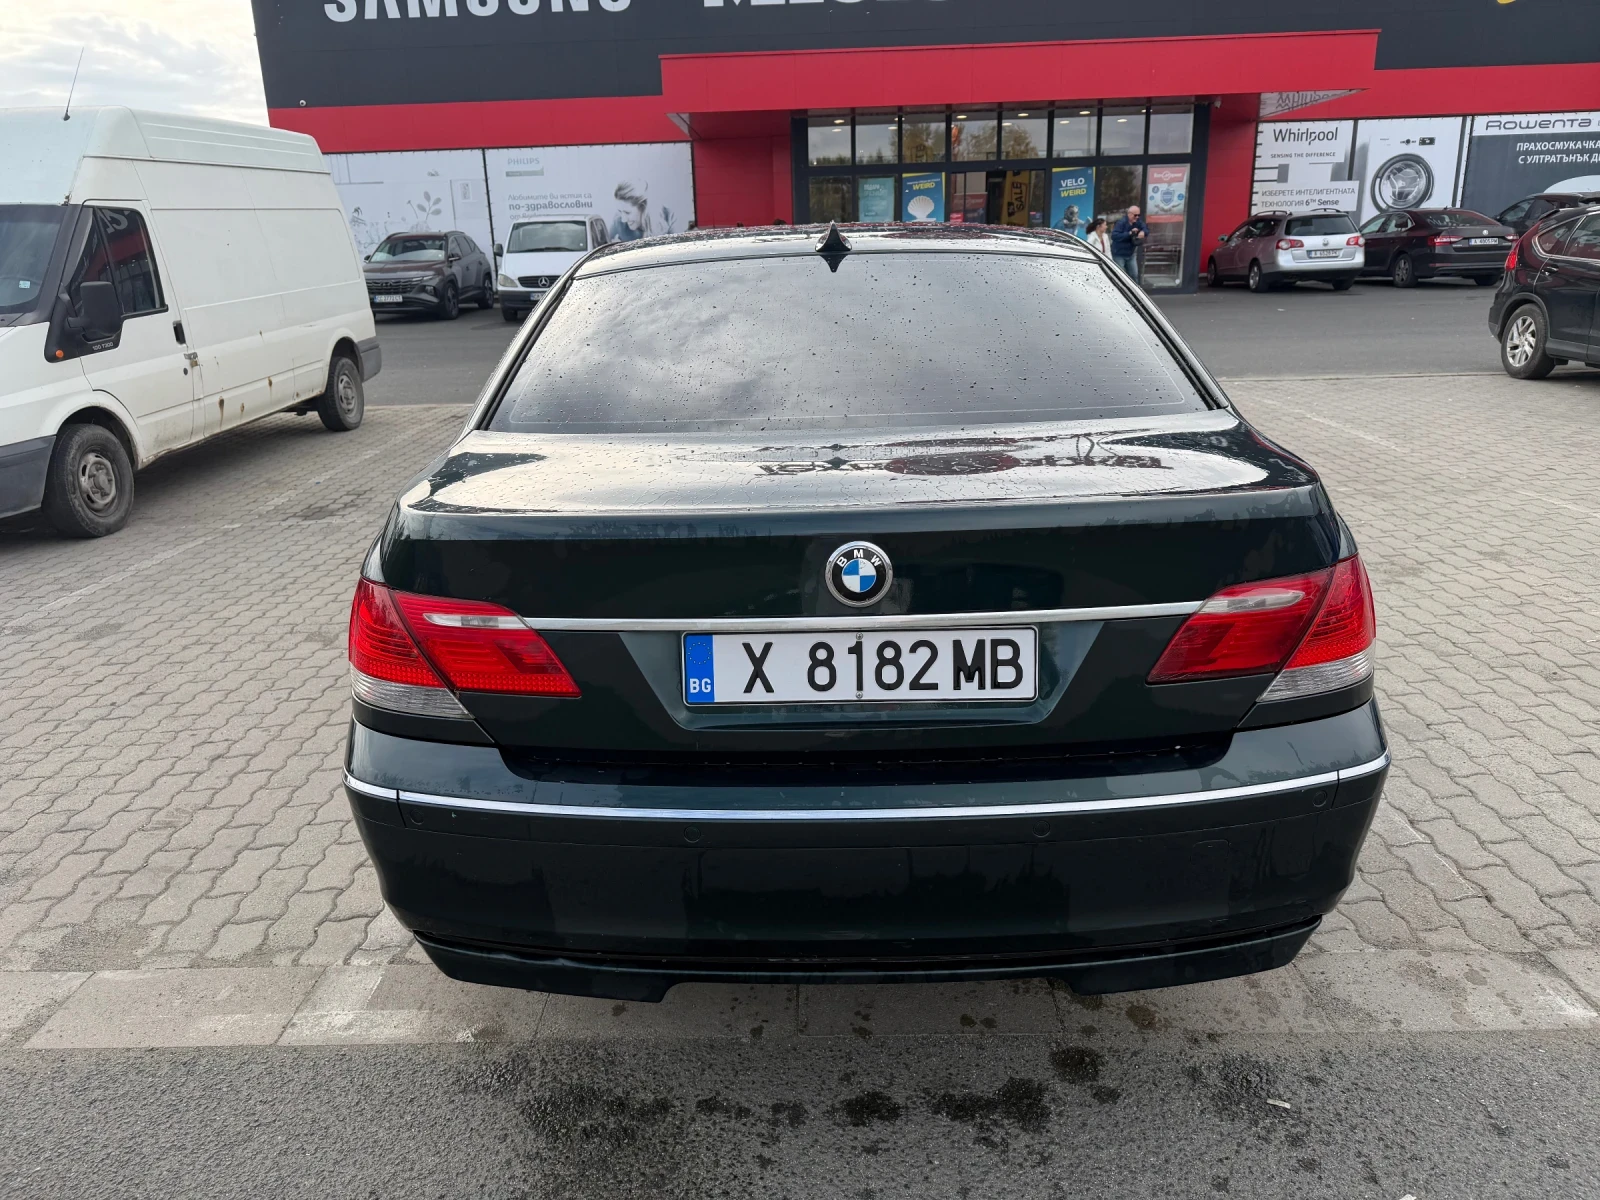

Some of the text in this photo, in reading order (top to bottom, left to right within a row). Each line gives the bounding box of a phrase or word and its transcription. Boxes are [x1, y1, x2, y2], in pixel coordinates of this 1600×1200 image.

[1273, 126, 1339, 146] Whirlpool
[1516, 140, 1600, 151] ПРАХОСМУКАЧКА
[507, 157, 540, 165] PHILIPS
[1526, 153, 1590, 164] УЛТРАТЪНЪК
[912, 182, 936, 191] WEIRD
[1060, 177, 1085, 187] VELO
[508, 193, 549, 201] Любимите
[549, 192, 559, 200] ви
[1013, 182, 1025, 212] SALE
[1060, 188, 1087, 198] WEIRD
[1261, 187, 1355, 197] ИЗБЕРЕТЕ ИНТЕЛИГЕНТНАТА
[508, 200, 593, 211] по-здравословни
[1261, 199, 1304, 208] ТЕХНОЛОГИЯ
[1317, 198, 1340, 206] Sense
[836, 549, 882, 567] BMW
[741, 638, 1024, 694] X 8182 MB
[689, 678, 712, 693] BG
